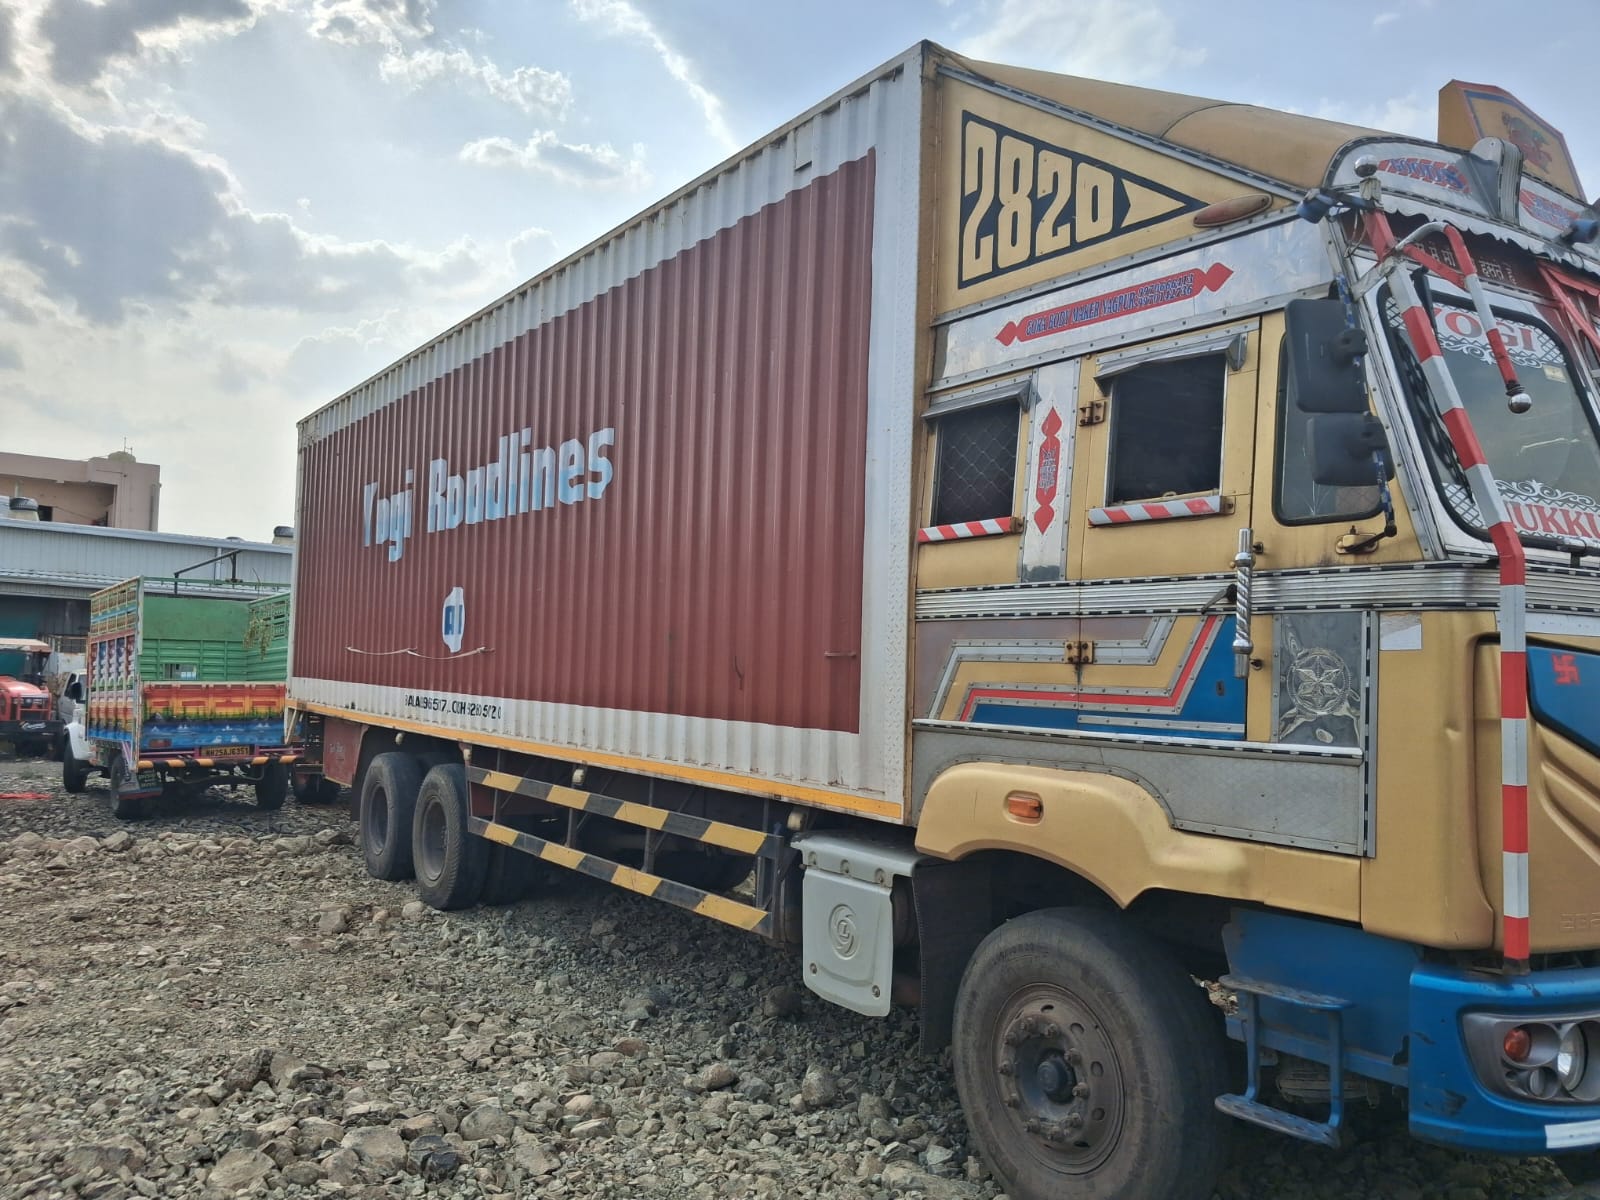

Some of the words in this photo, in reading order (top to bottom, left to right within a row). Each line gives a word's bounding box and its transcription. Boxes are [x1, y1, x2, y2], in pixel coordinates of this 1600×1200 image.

[962, 120, 1114, 281] 2820
[1433, 307, 1536, 352] OGI
[363, 469, 414, 563] Yogi
[427, 427, 614, 533] Roadlines
